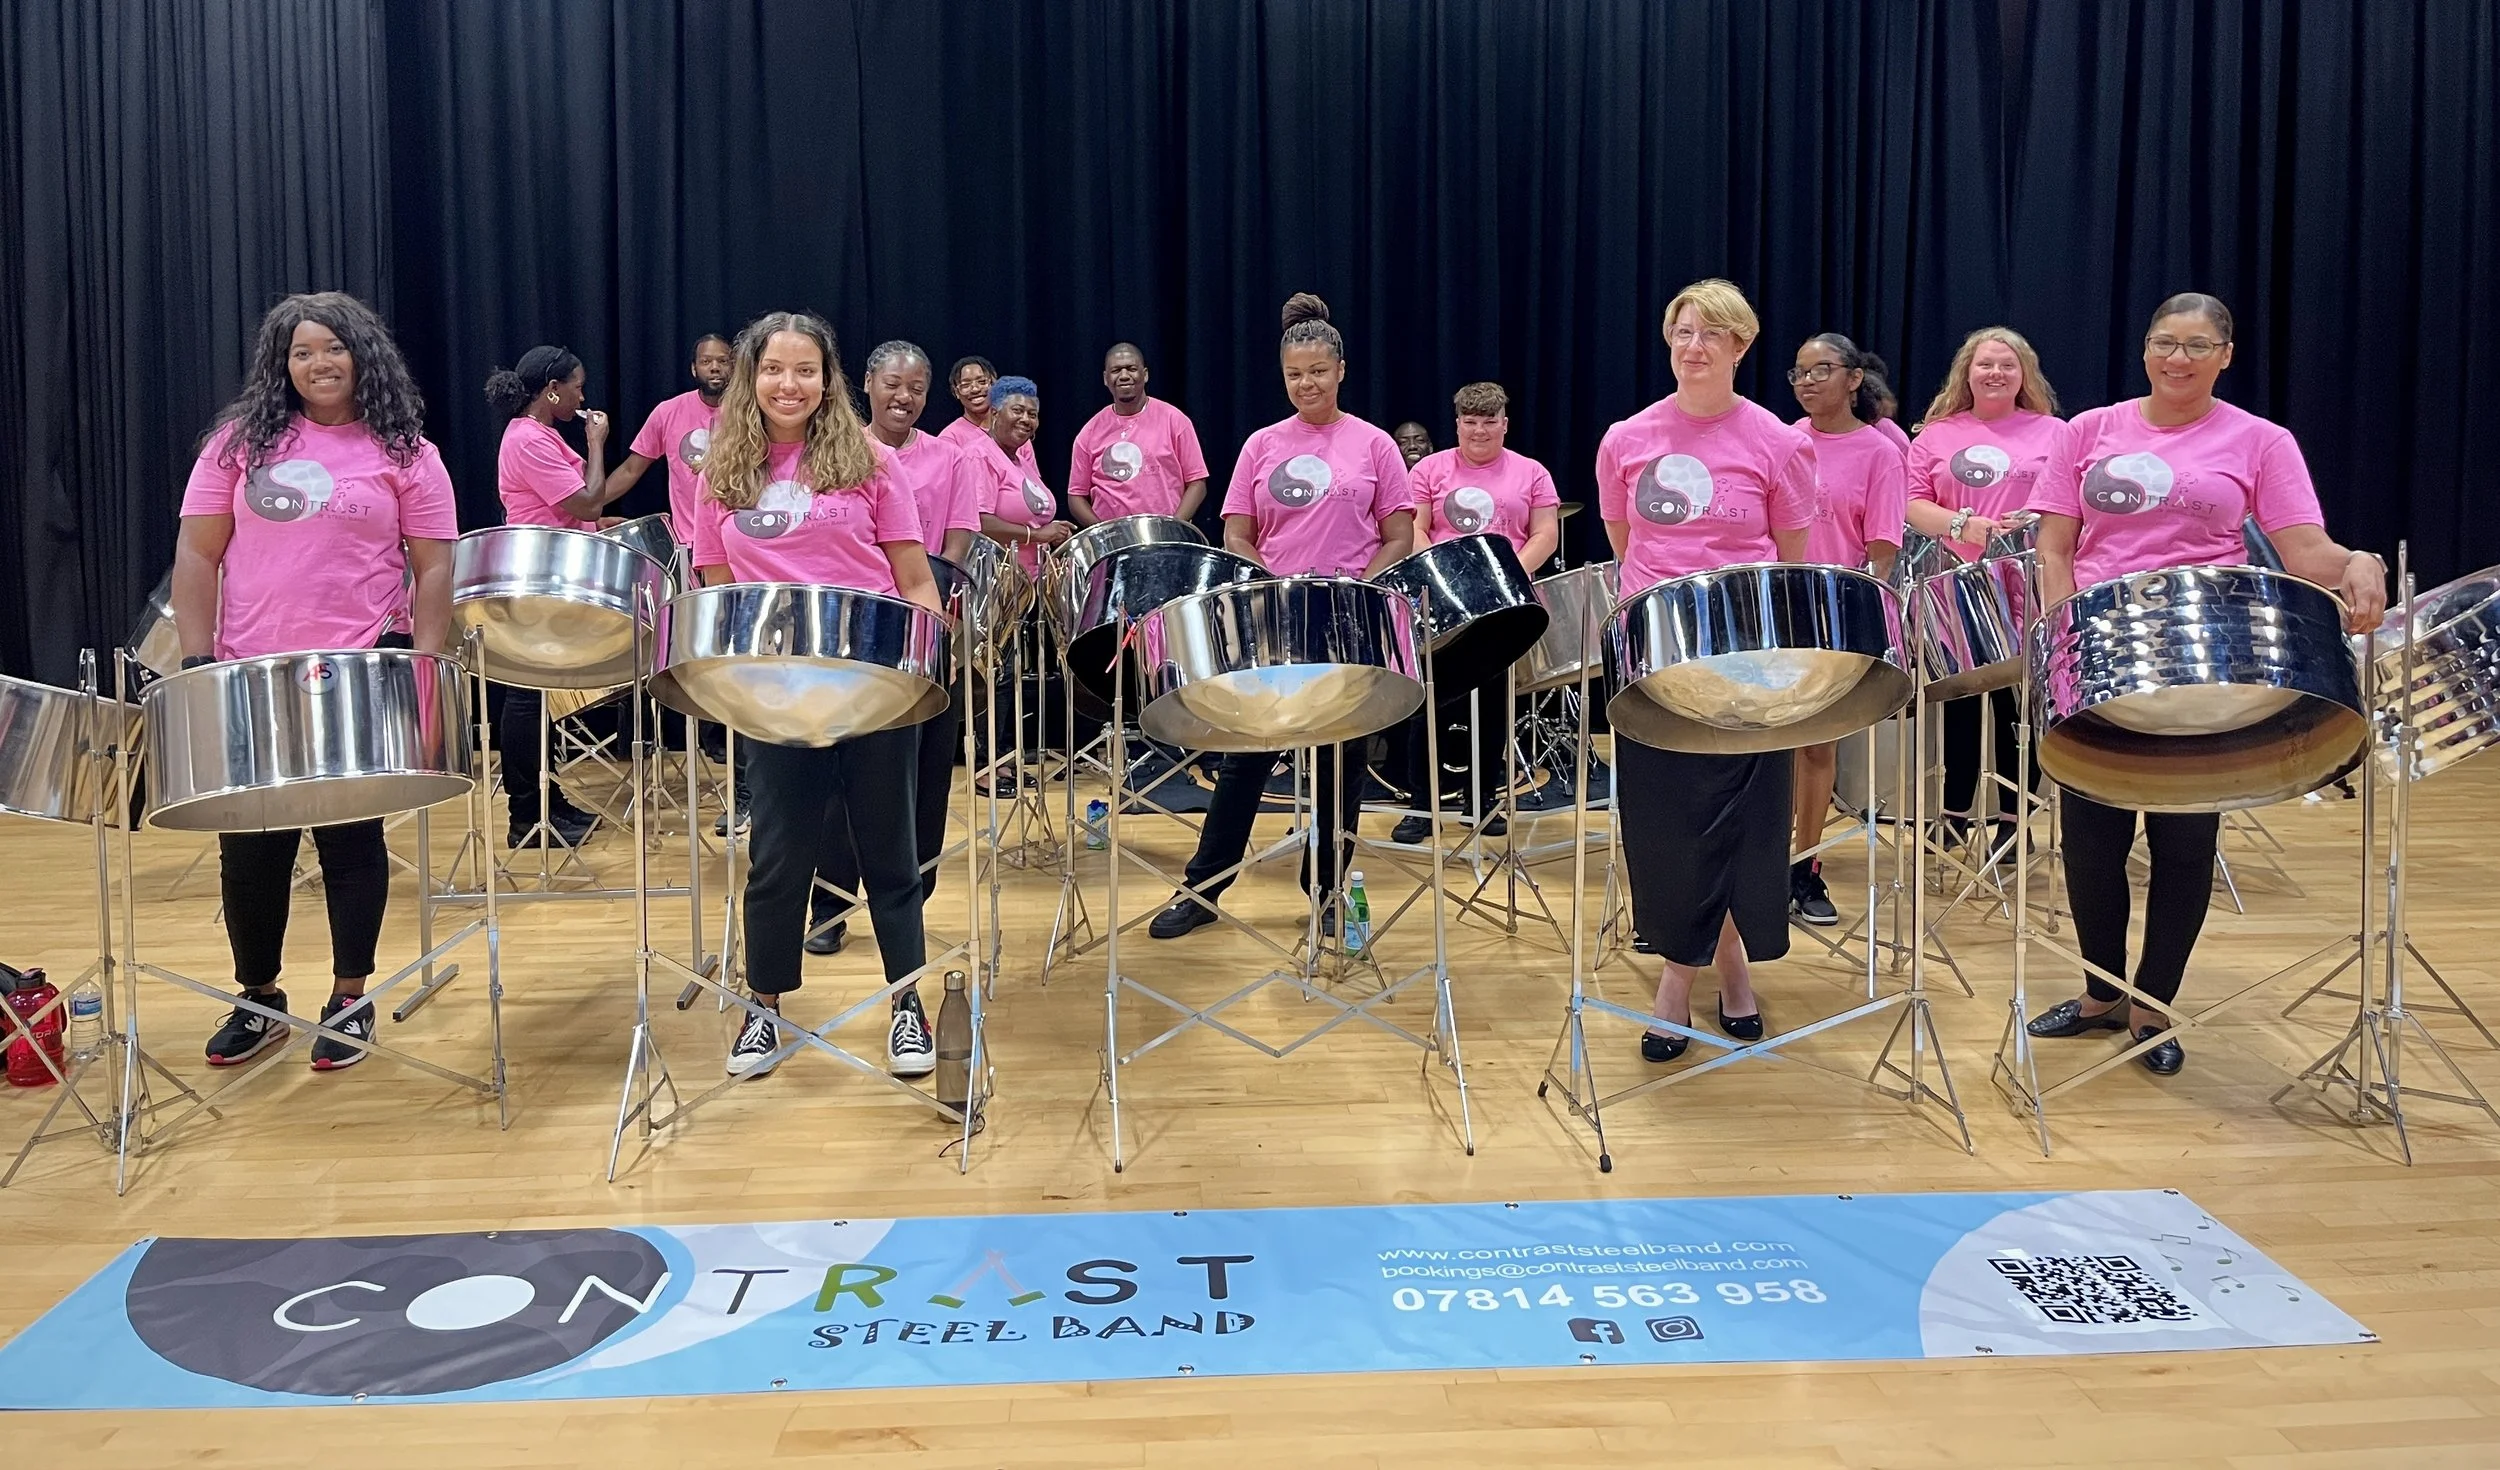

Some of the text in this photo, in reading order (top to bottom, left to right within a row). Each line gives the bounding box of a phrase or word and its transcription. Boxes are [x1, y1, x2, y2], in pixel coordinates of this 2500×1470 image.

[1965, 468, 2036, 480] CONTRAST
[1282, 485, 1358, 498] CONTRAST
[261, 496, 372, 517] CONTRAST
[1649, 501, 1749, 519] CONTRAST
[2096, 490, 2217, 515] CONTRAST
[750, 507, 849, 527] CONTRAST
[1376, 1240, 1796, 1261] www.contraststeelband.com
[1381, 1258, 1809, 1280] bookings@contraststeelband.com
[272, 1250, 1256, 1332] CONTRAST
[1392, 1278, 1828, 1313] 07814 563 958
[808, 1310, 1256, 1348] STEEL BAND
